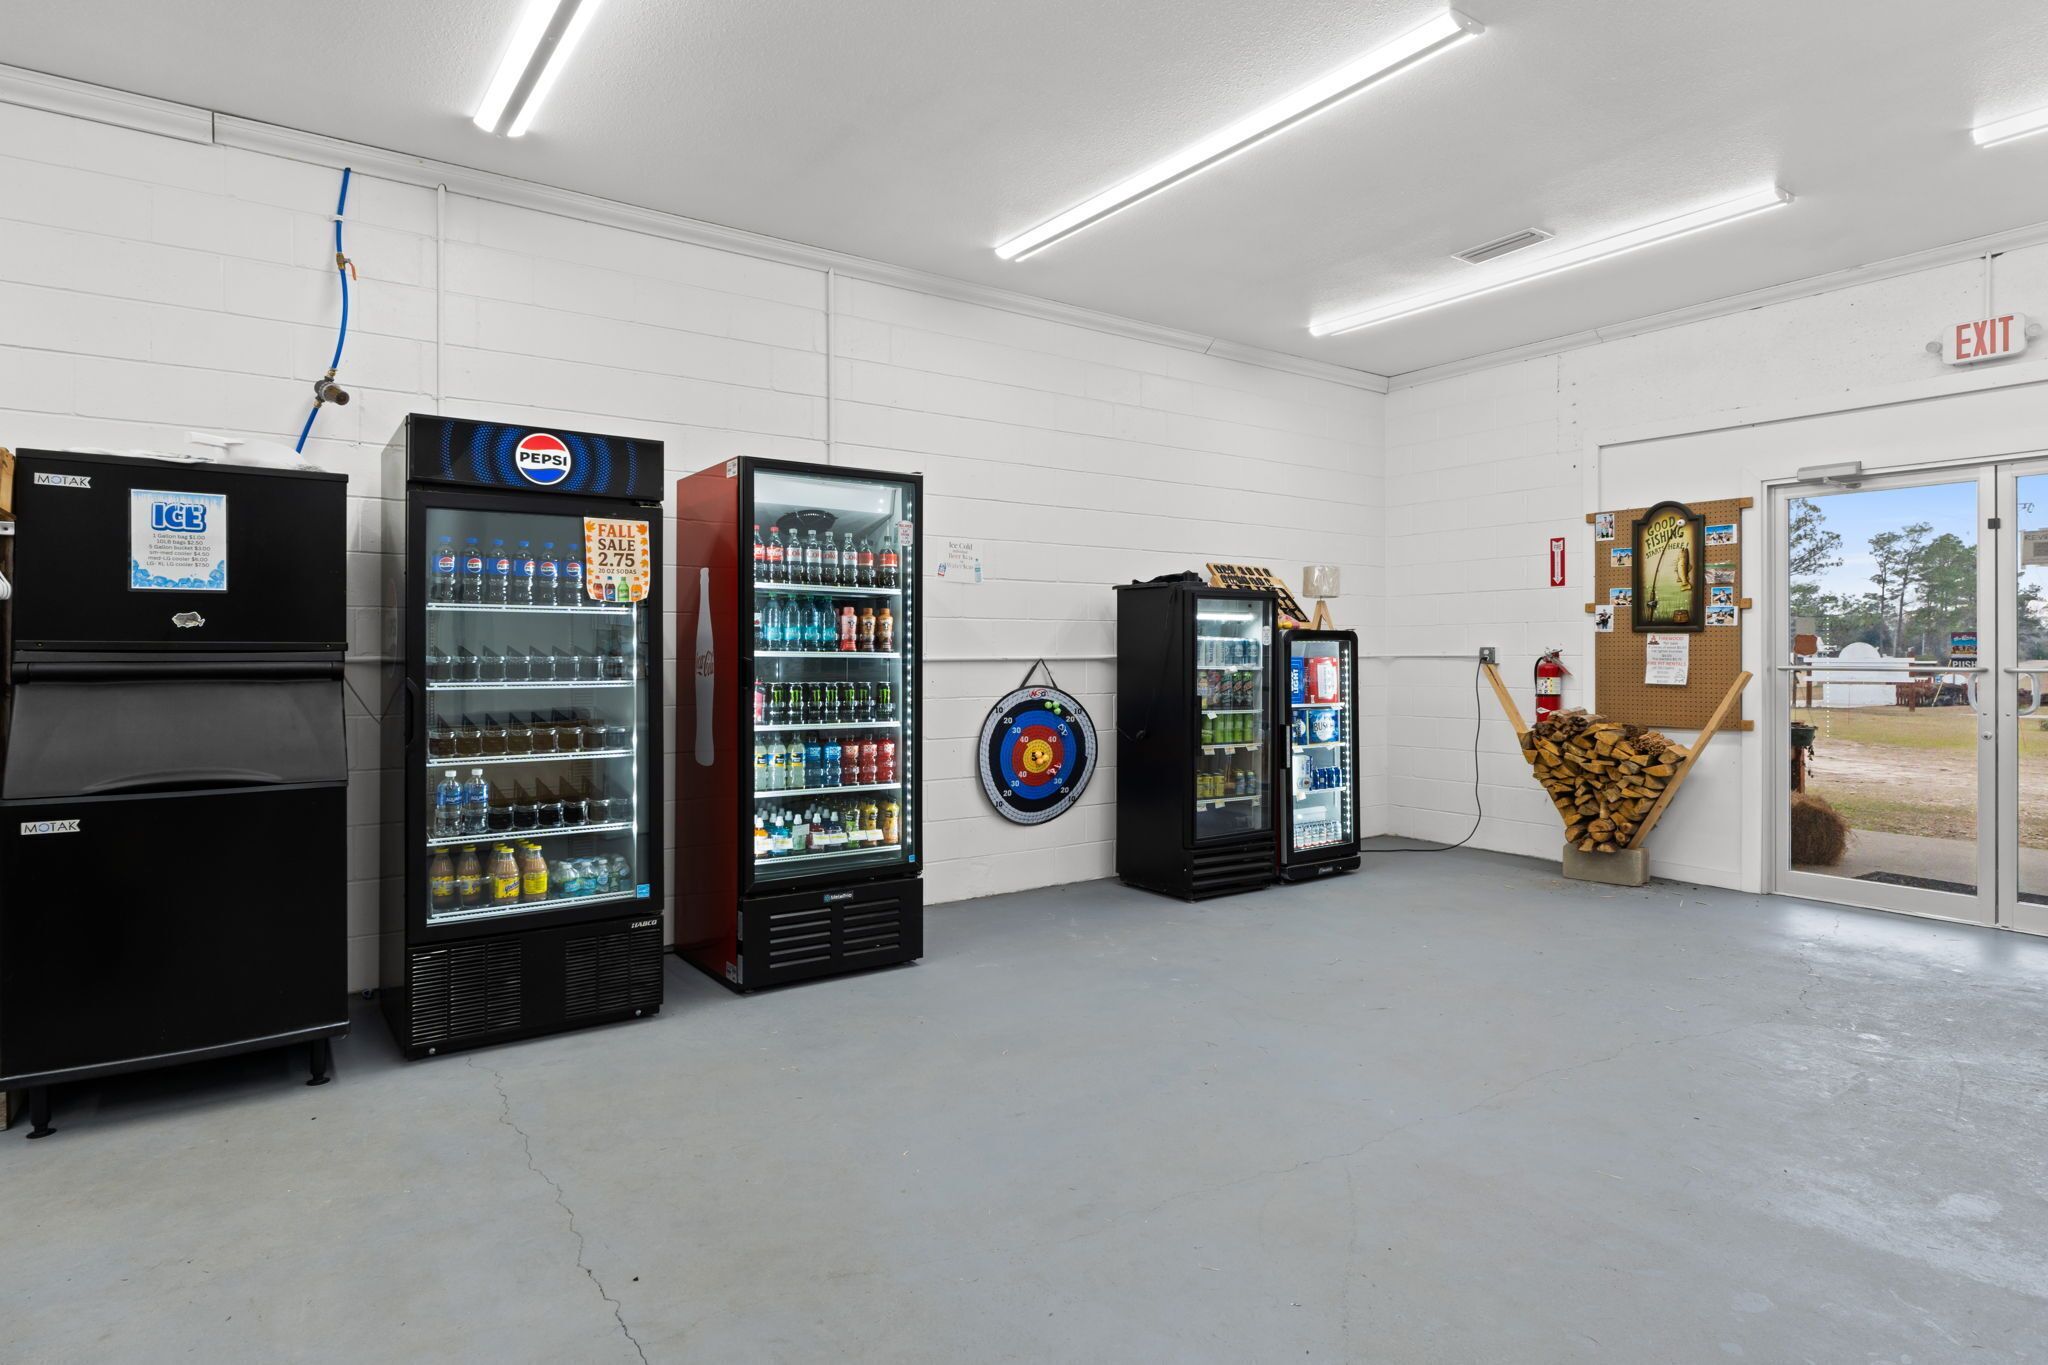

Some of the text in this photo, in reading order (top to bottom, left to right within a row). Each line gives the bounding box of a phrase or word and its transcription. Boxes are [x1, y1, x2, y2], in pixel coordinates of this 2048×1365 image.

[1956, 316, 2014, 360] EXIT
[520, 451, 567, 466] PEPSI
[37, 475, 87, 486] MOTAK
[152, 502, 206, 532] ICE
[598, 524, 635, 539] FALL
[1647, 516, 1676, 537] GOOD
[598, 538, 635, 551] SALE
[1645, 524, 1684, 550] FISHING
[598, 552, 635, 567] 2.75
[1646, 545, 1665, 559] STARTS
[1952, 660, 1977, 668] PUSH
[1018, 770, 1027, 778] 40
[24, 821, 77, 833] MOTAK
